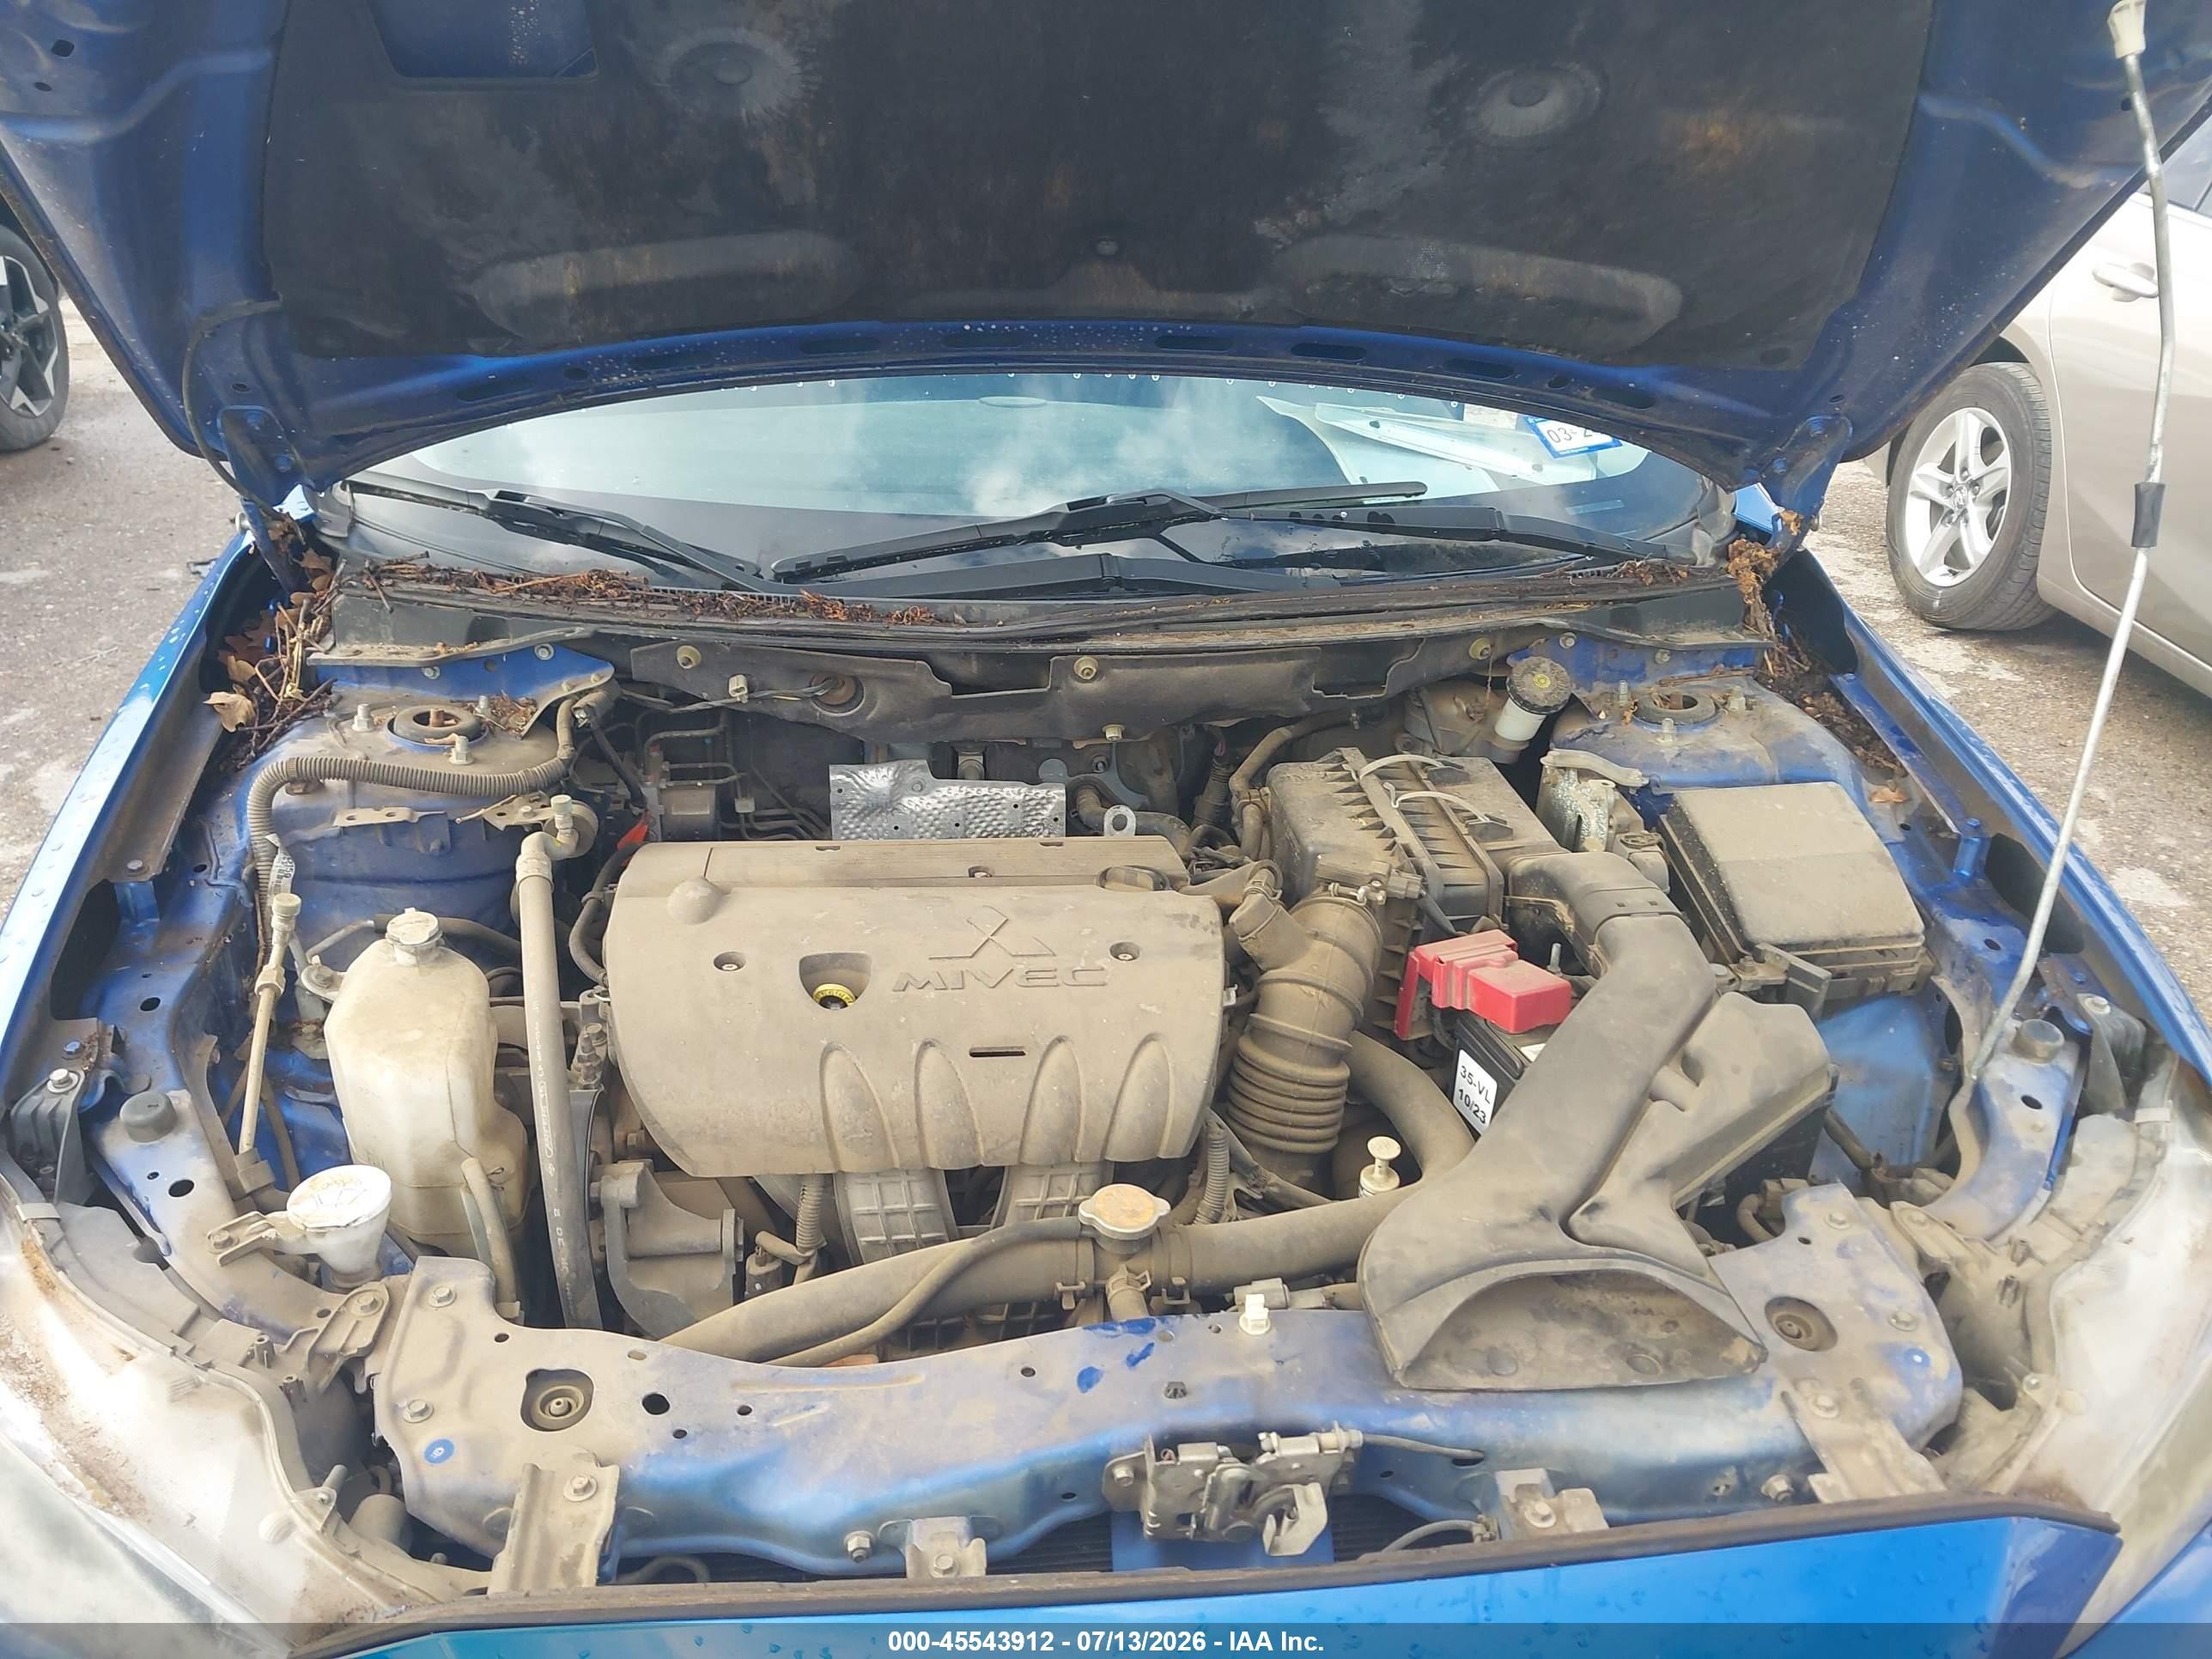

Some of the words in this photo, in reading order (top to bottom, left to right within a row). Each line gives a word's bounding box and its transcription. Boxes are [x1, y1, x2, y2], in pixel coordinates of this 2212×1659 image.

[892, 967, 1108, 992] MIVEC
[1460, 1065, 1491, 1104] 35-VL
[1458, 1088, 1486, 1124] 10/23
